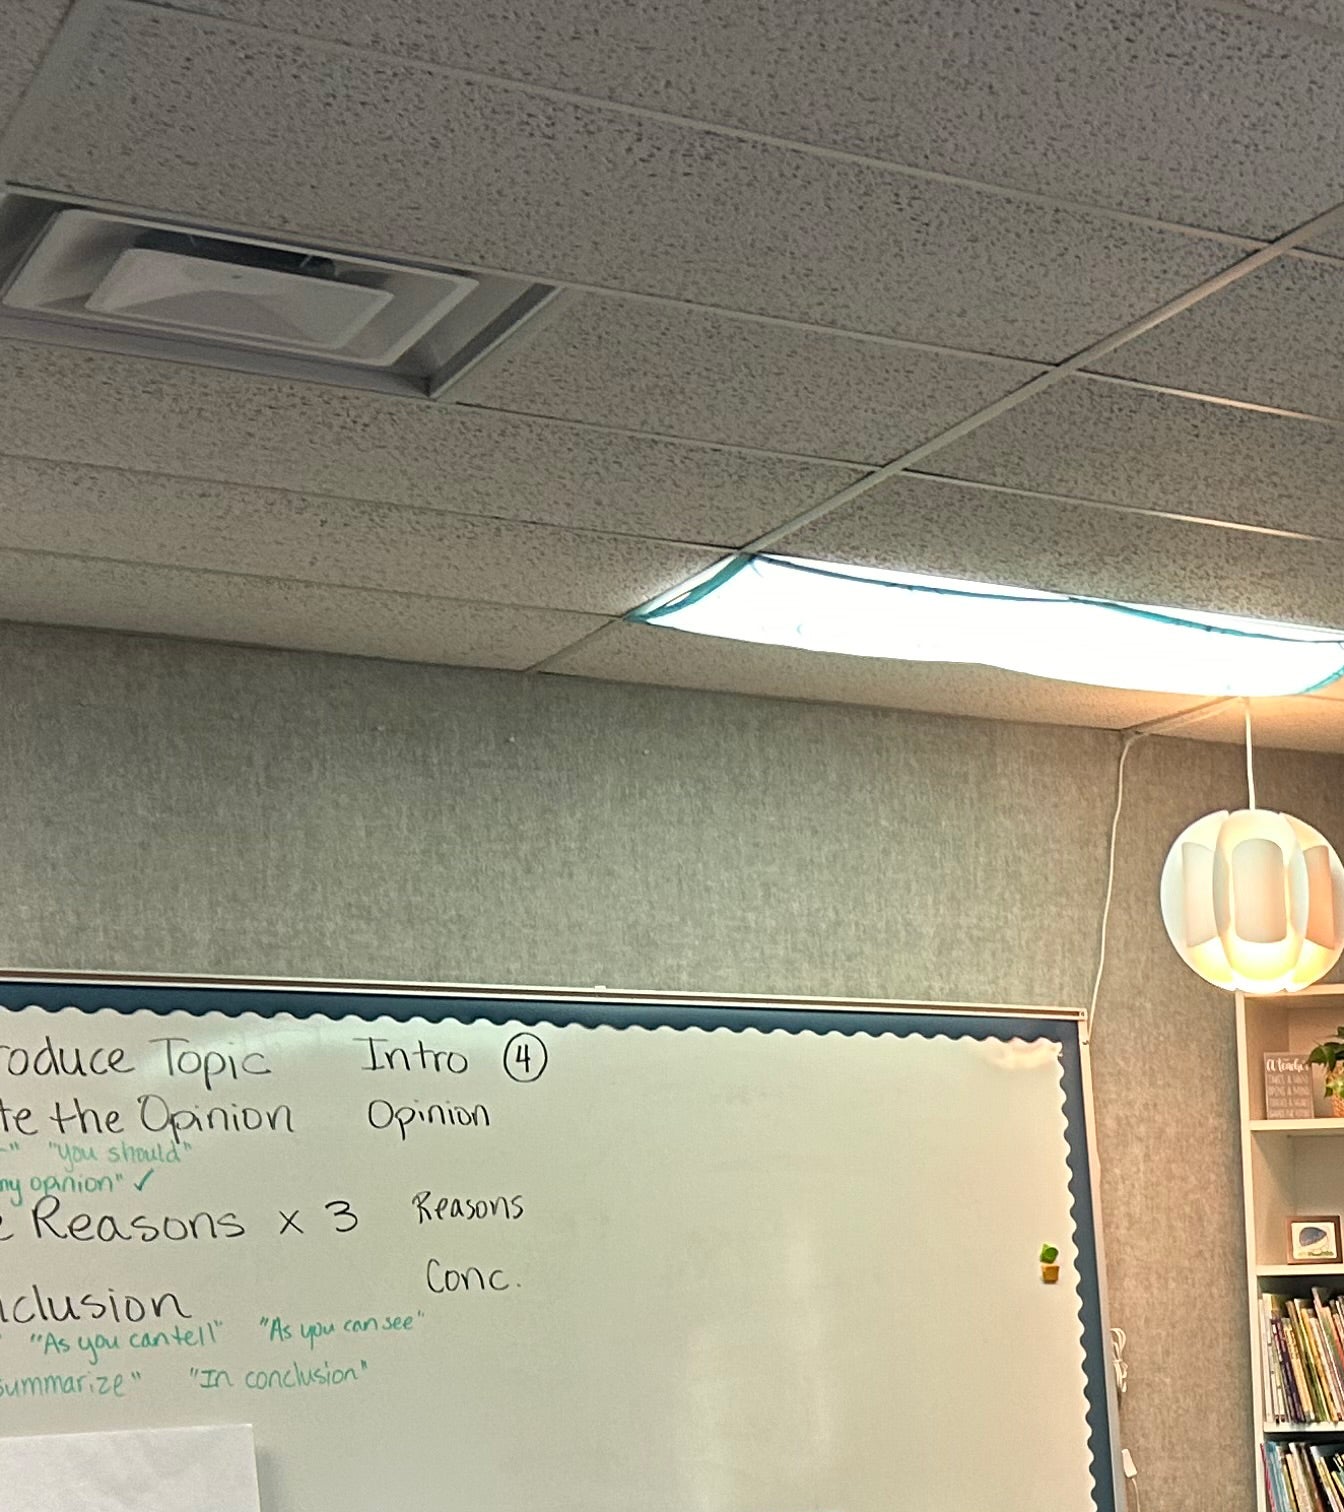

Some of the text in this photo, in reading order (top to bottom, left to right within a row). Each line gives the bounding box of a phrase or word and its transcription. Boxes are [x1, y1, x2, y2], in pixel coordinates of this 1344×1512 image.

[149, 1038, 271, 1090] Topic
[352, 1037, 468, 1073] Intro
[50, 1098, 124, 1133] the
[137, 1094, 294, 1144] Opinion
[368, 1099, 490, 1140] Opinion
[32, 1195, 244, 1242] Reasons
[325, 1200, 358, 1232] 3
[412, 1191, 524, 1224] Reasons
[427, 1258, 521, 1293] Conc.
[78, 1337, 119, 1365] you
[301, 1322, 334, 1350] you
